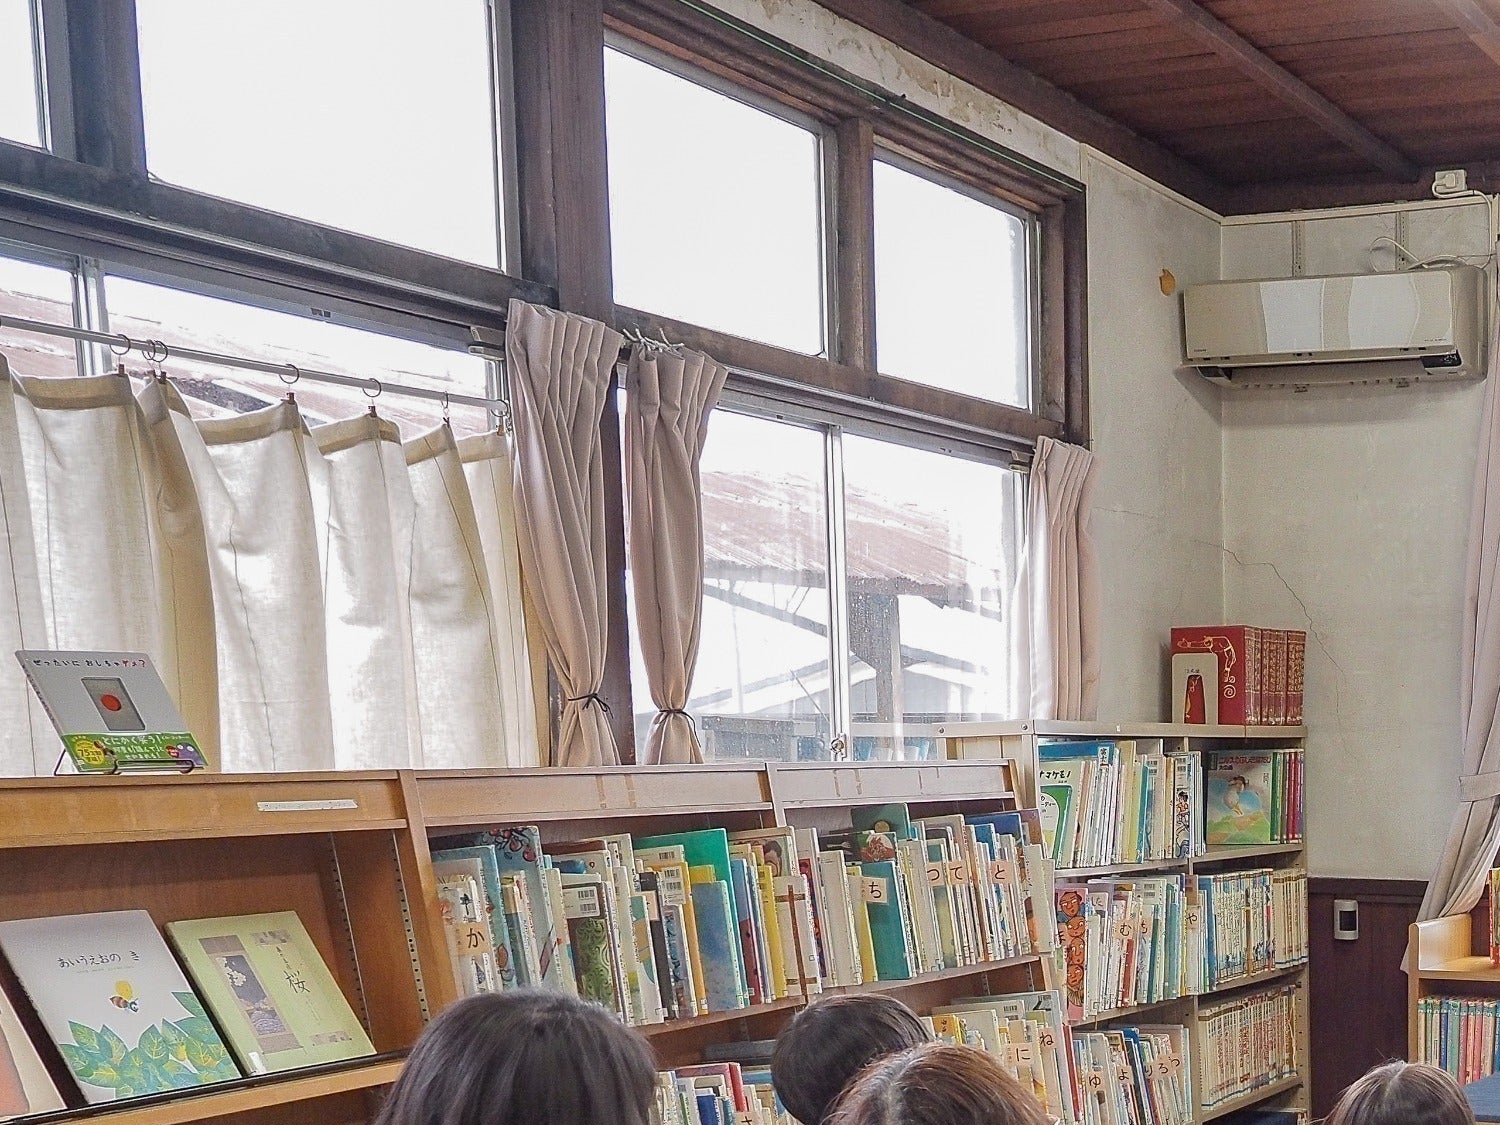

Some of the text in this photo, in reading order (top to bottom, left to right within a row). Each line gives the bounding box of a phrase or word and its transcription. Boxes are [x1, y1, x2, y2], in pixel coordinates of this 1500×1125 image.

[927, 868, 940, 881] つ
[950, 866, 963, 879] て
[994, 865, 1006, 880] と
[868, 881, 882, 899] ち
[1186, 912, 1198, 925] や
[1119, 924, 1132, 936] む
[466, 928, 485, 948] か
[58, 952, 121, 969] あいうえおの
[283, 969, 311, 996] 桜
[1039, 1031, 1054, 1046] ね
[1016, 1048, 1031, 1062] に
[1118, 1069, 1129, 1081] よ
[1158, 1062, 1169, 1074] ろ
[1088, 1074, 1101, 1088] ゆ
